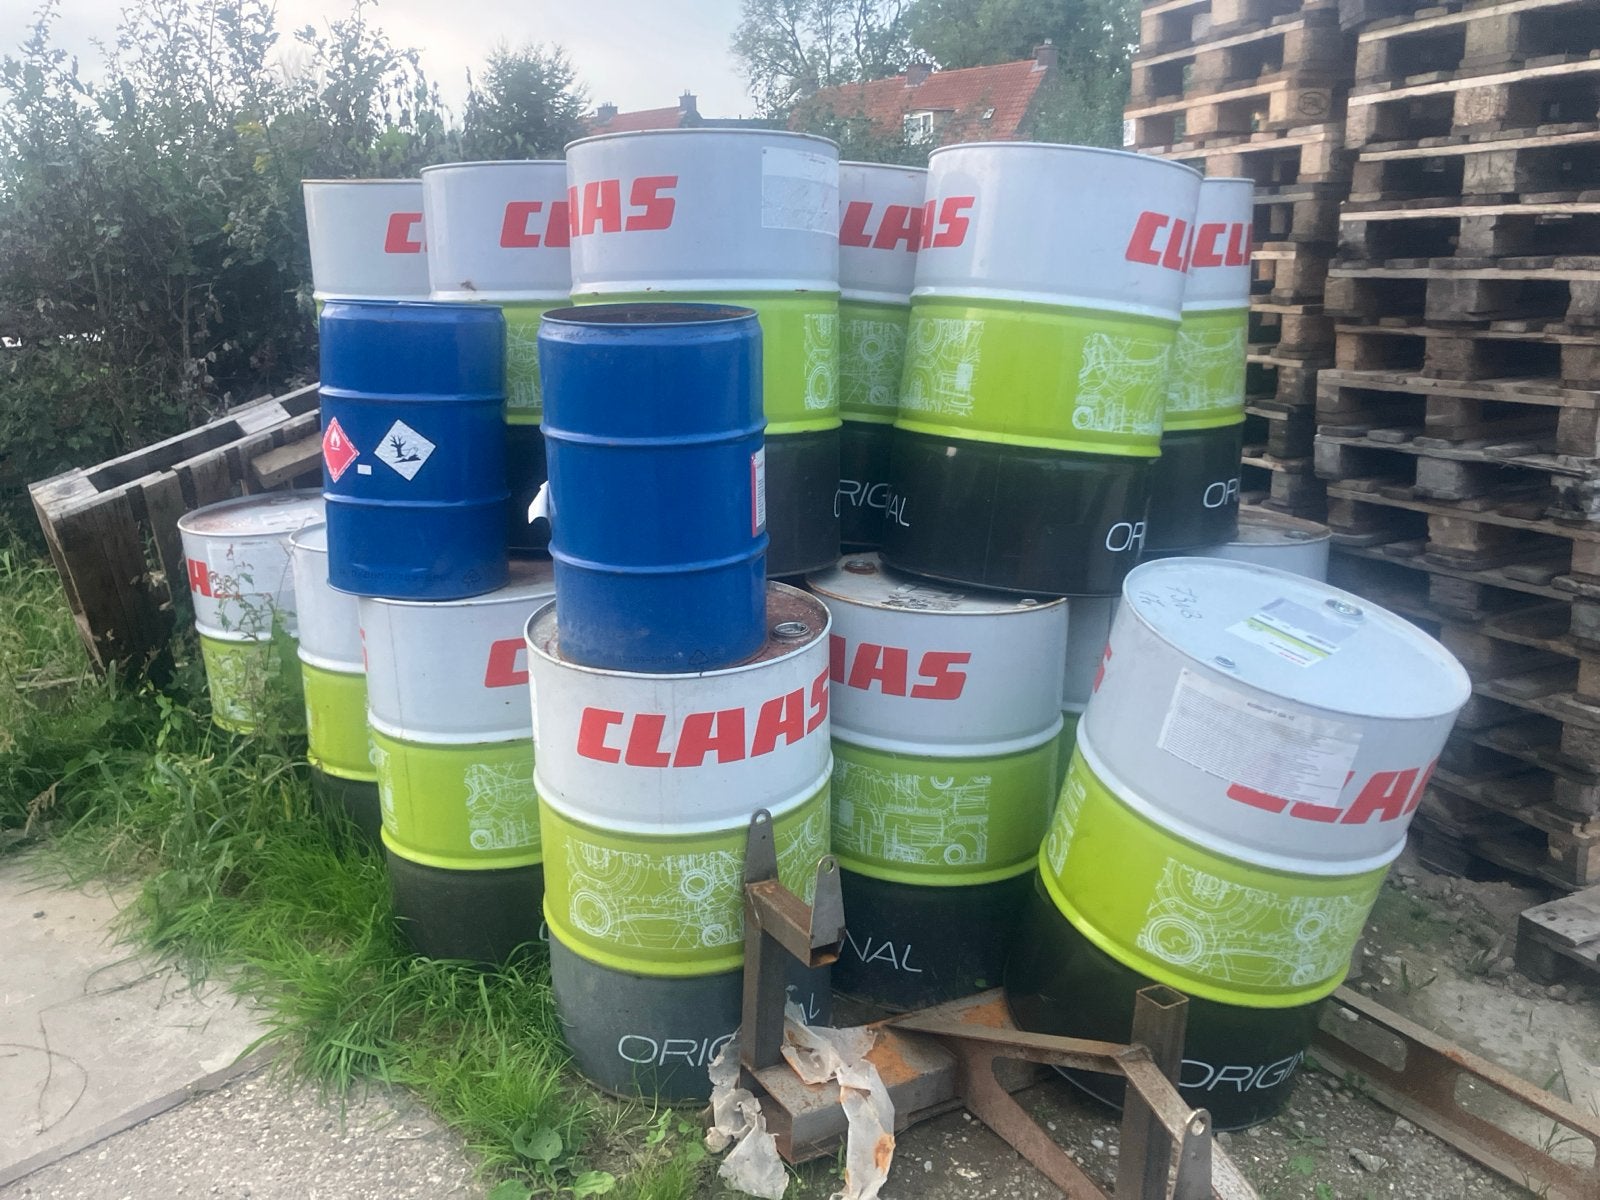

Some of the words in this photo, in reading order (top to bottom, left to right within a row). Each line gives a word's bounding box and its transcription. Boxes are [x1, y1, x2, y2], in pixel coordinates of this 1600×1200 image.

[1125, 211, 1194, 273] CL
[1191, 223, 1253, 267] CL
[577, 666, 829, 768] CLAAS
